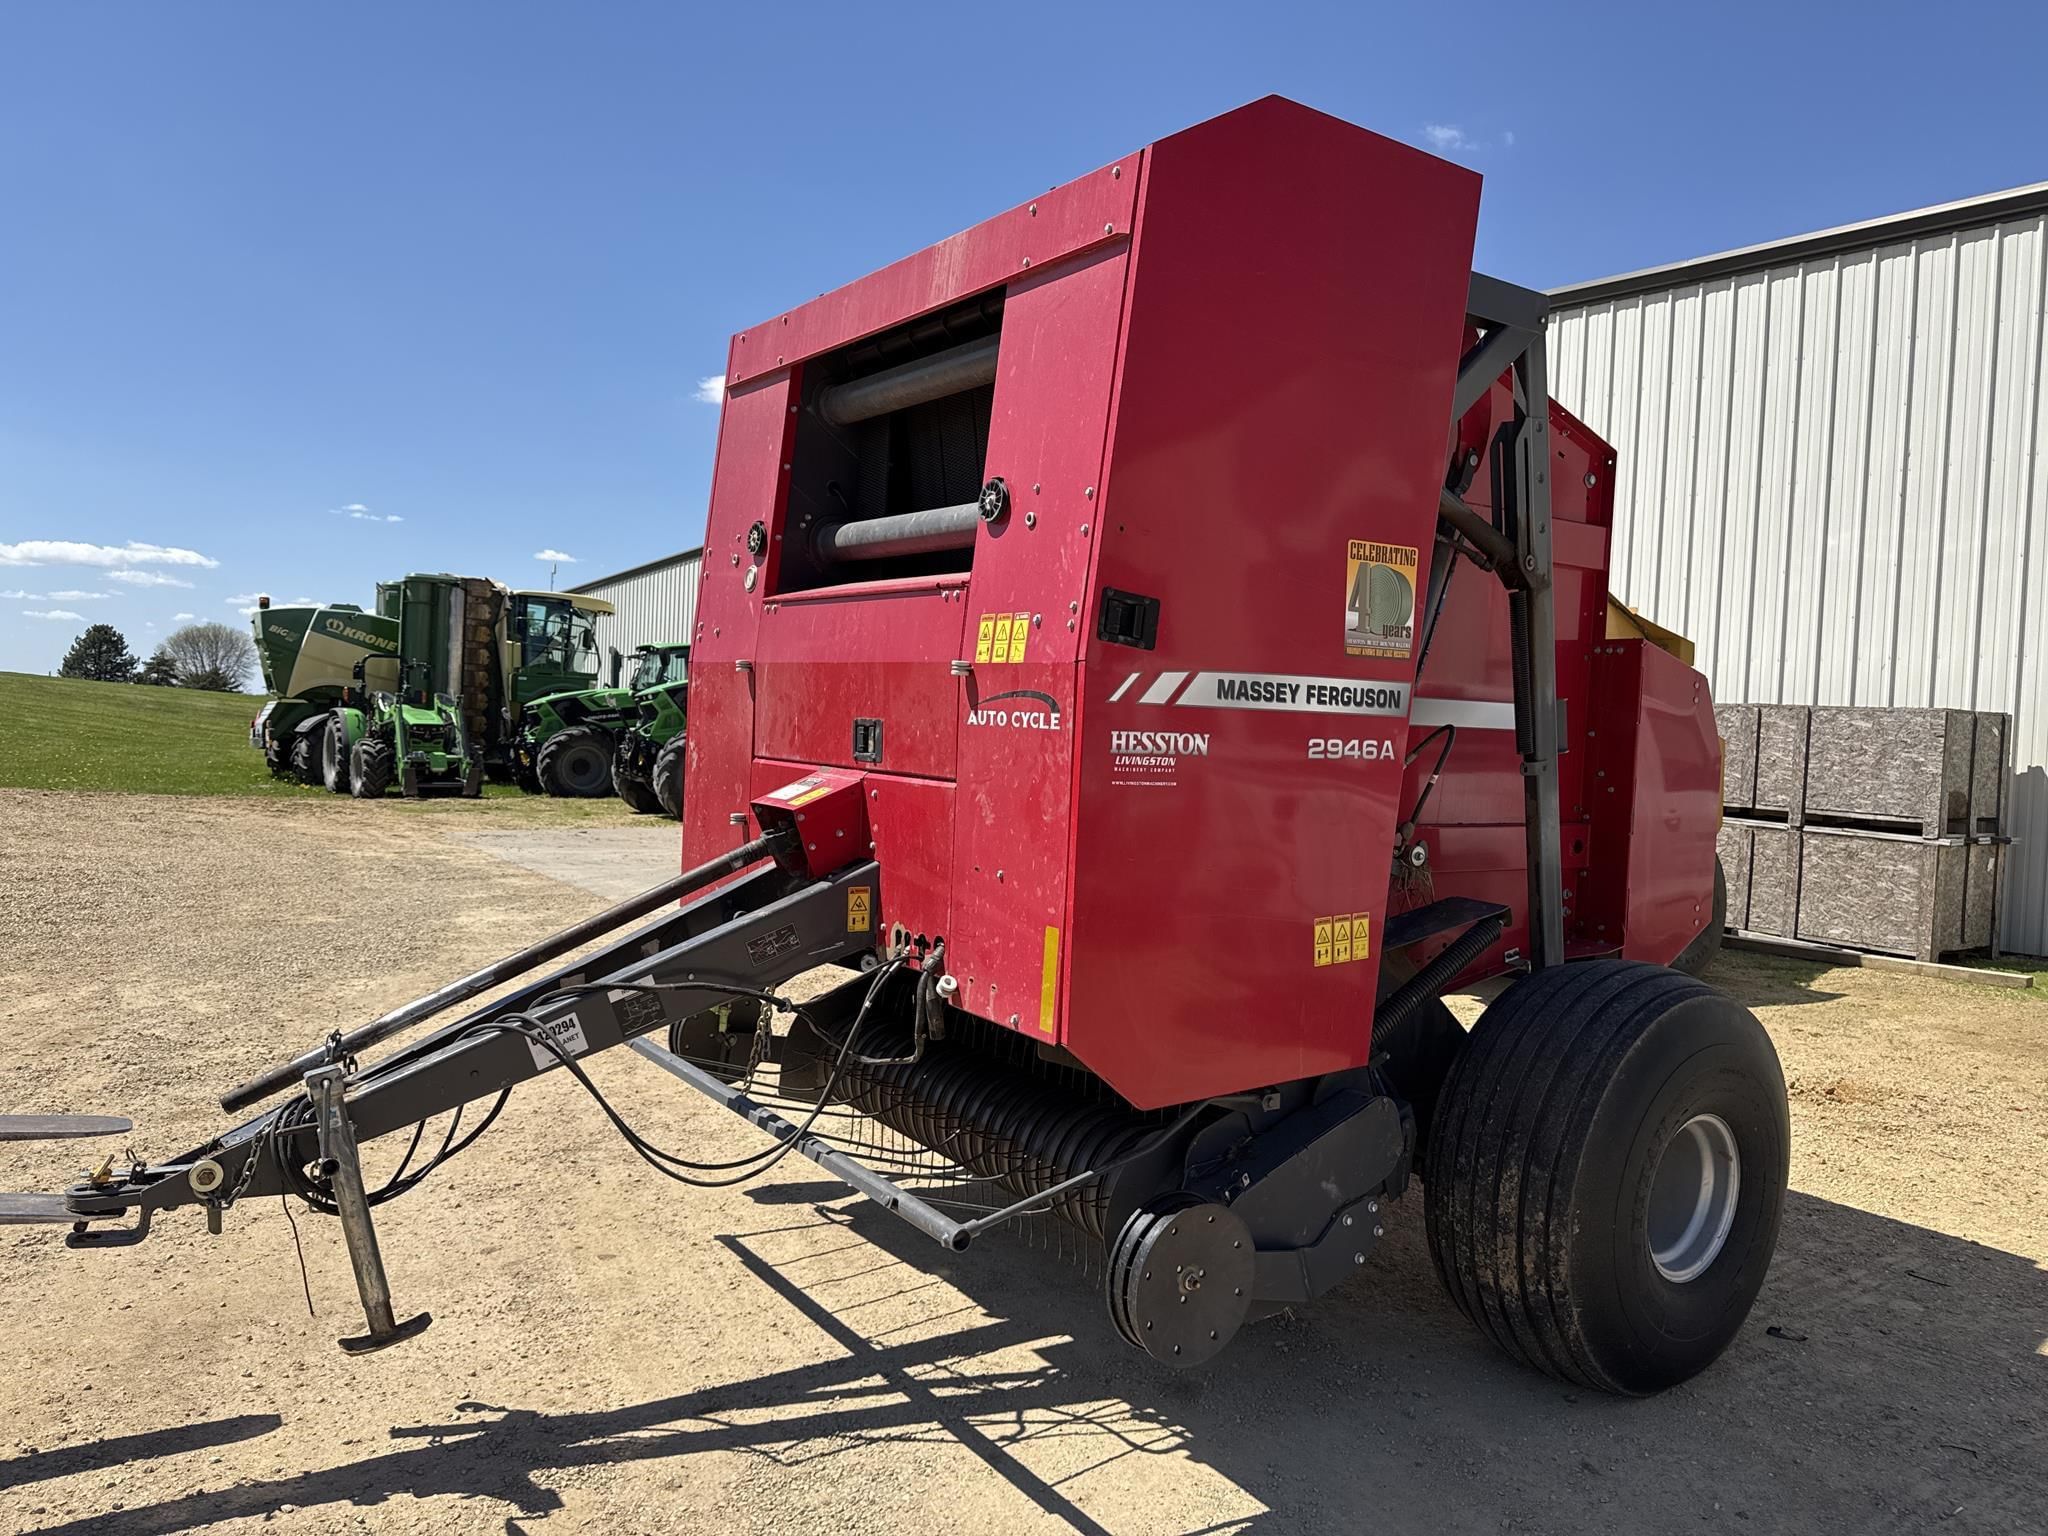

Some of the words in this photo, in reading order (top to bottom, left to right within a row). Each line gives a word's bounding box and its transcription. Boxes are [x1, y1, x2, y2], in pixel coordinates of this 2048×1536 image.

[1349, 541, 1417, 567] CELEBRATING
[342, 627, 398, 651] KRONE
[1383, 624, 1411, 639] years
[1217, 679, 1300, 704] MASSEY
[1306, 684, 1401, 709] FERGUSON
[967, 710, 1007, 726] AUTO
[1011, 711, 1060, 730] CYCLE
[1110, 731, 1210, 756] HESSTON
[1308, 738, 1395, 760] 2946A
[1115, 756, 1176, 766] LIVINGSTON
